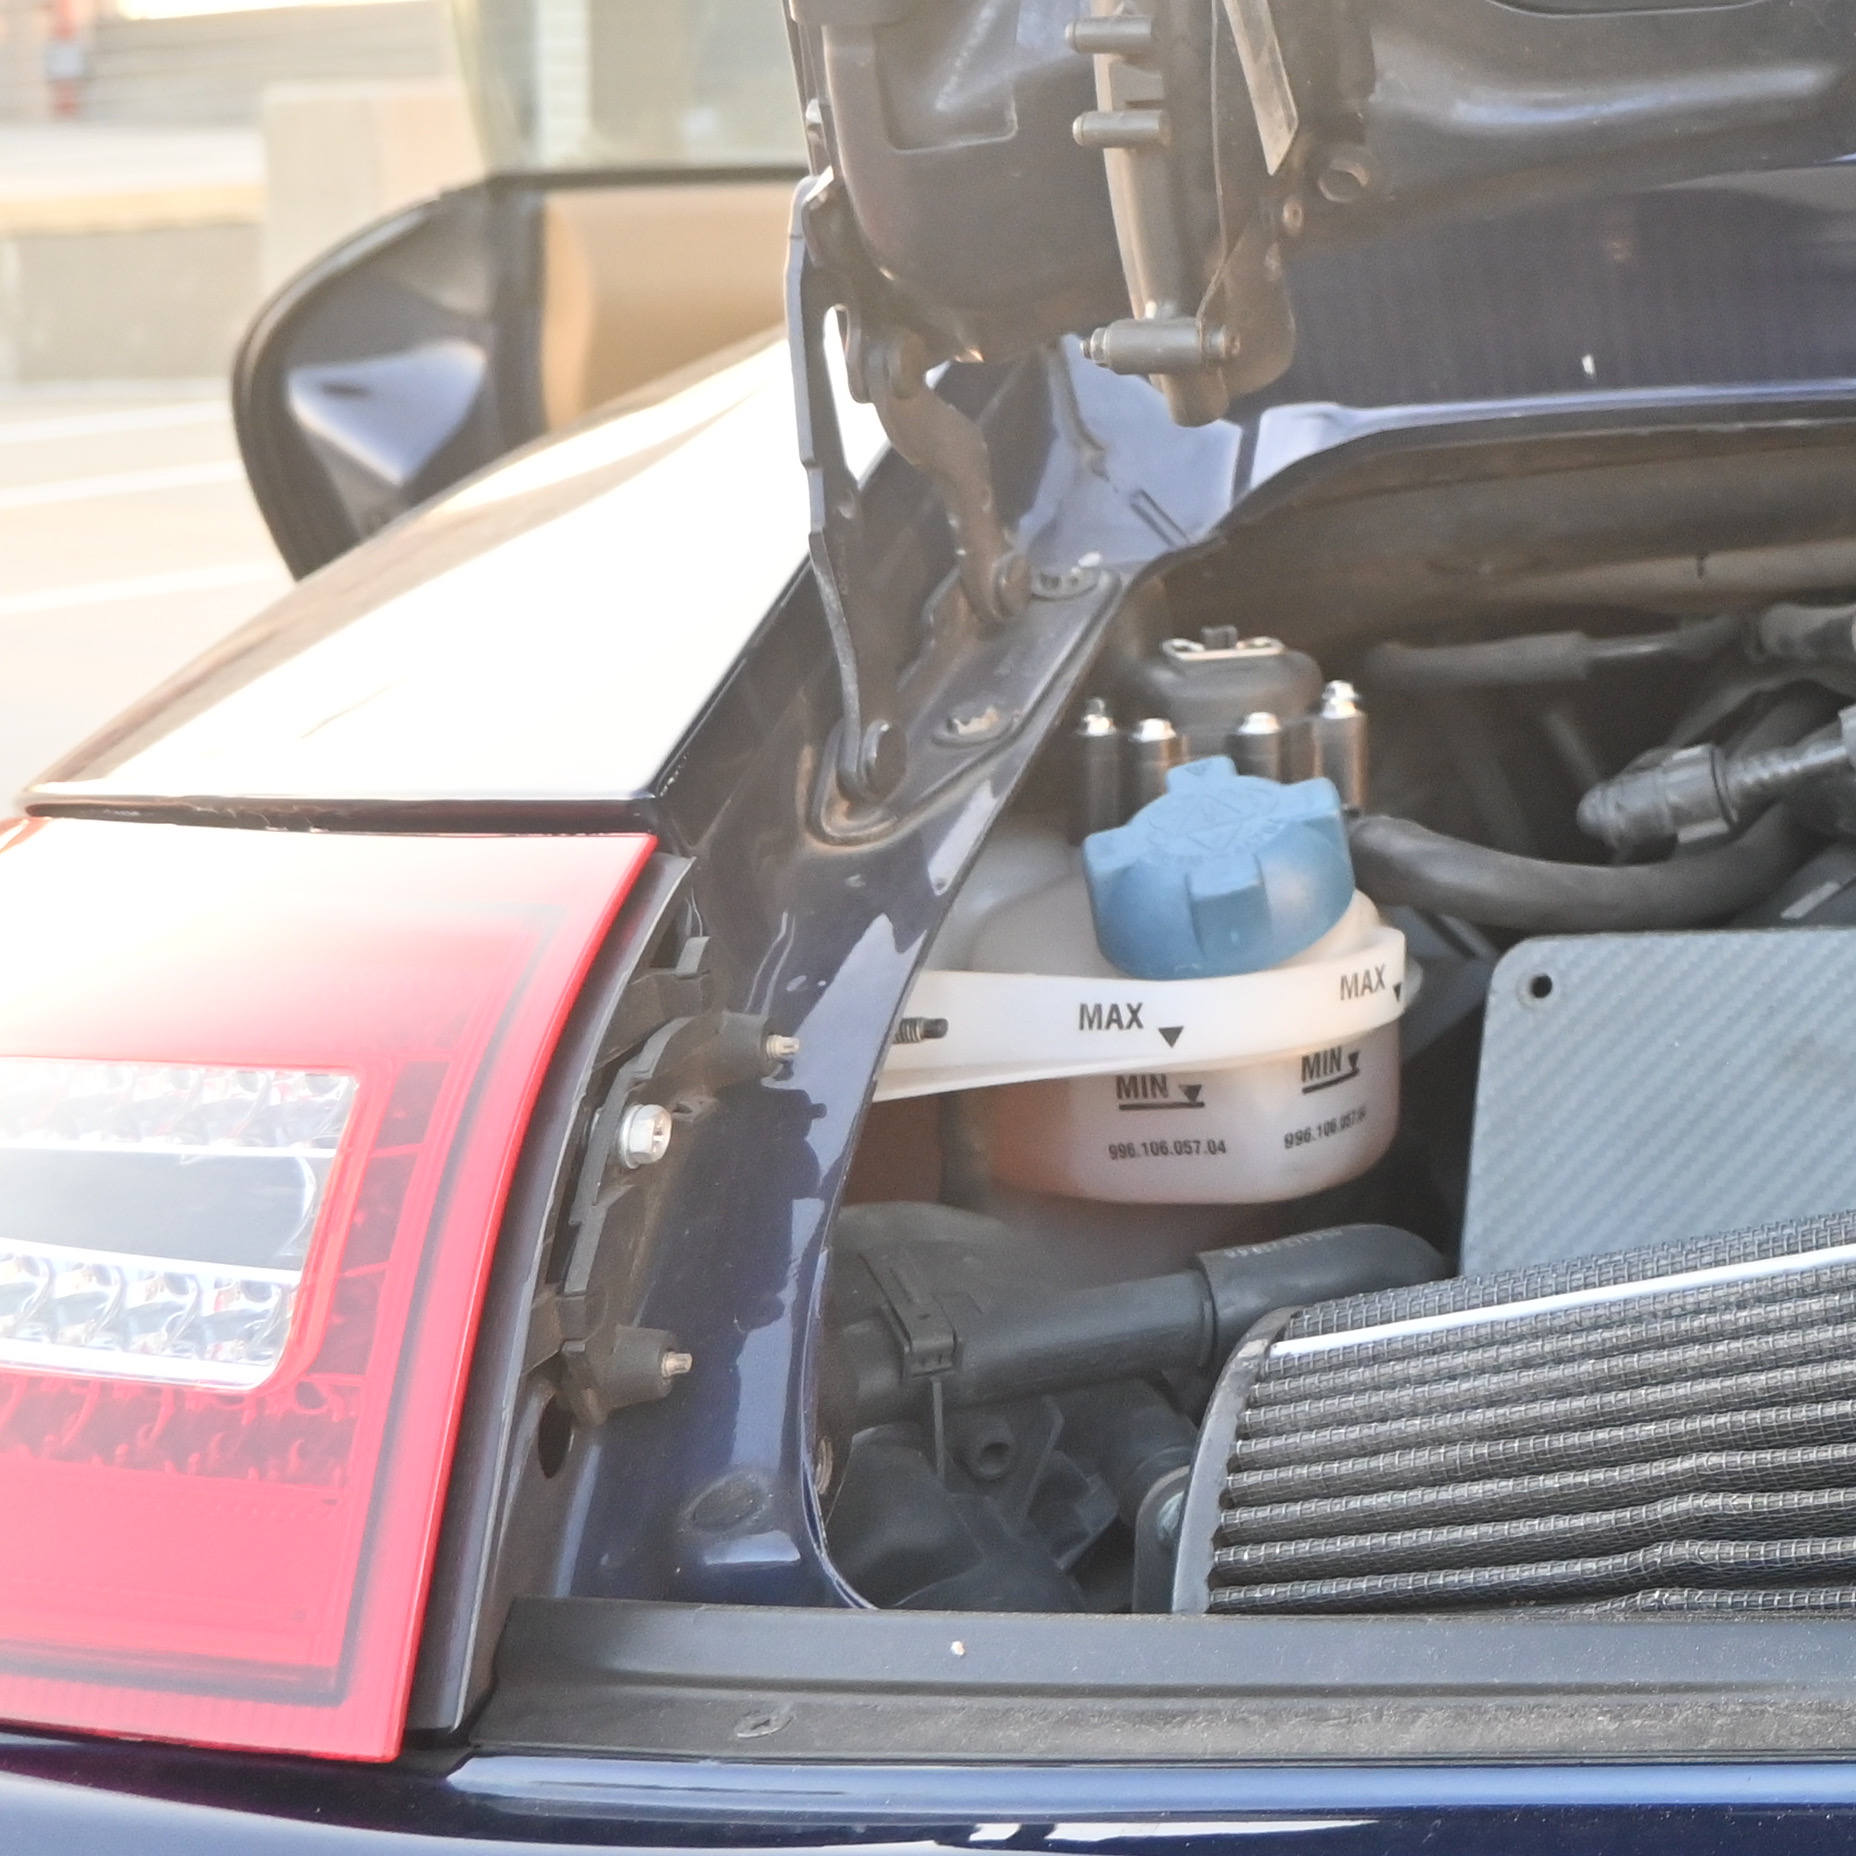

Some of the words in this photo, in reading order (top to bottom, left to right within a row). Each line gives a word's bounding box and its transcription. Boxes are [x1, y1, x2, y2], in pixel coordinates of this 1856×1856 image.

[1338, 963, 1387, 1001] MAX
[1078, 1002, 1145, 1032] MAX
[1301, 1046, 1343, 1082] MIN
[1115, 1074, 1169, 1100] MIN
